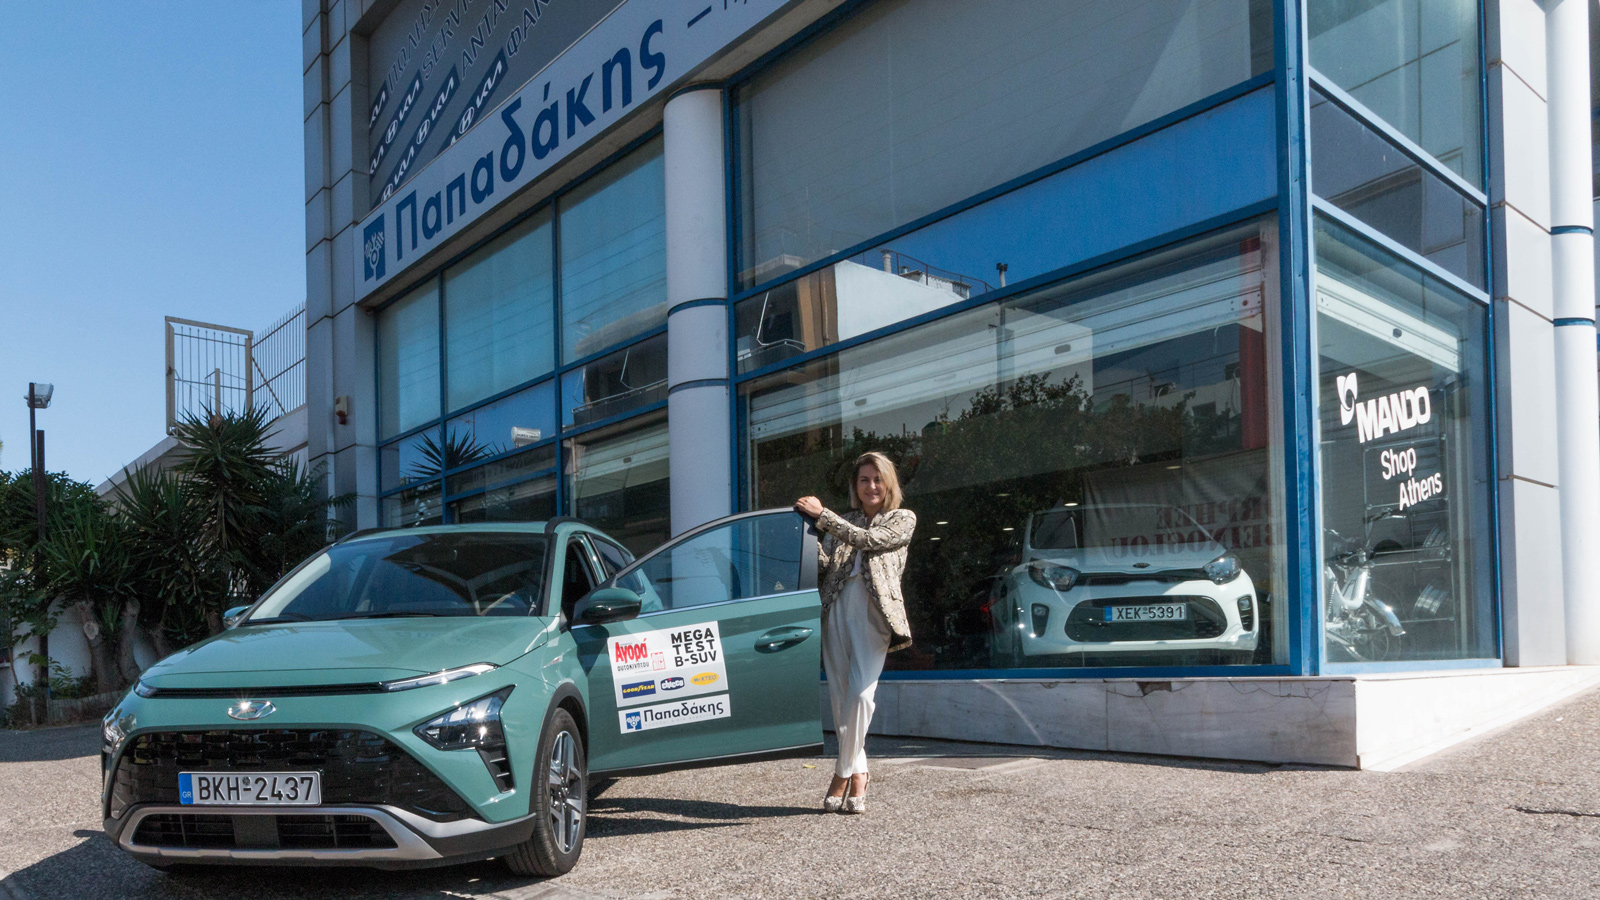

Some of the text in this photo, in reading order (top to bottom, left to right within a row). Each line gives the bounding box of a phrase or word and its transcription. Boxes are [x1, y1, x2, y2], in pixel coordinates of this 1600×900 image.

[395, 18, 667, 261] Παπαδάκης
[1355, 386, 1431, 443] MANDO
[1381, 447, 1417, 480] Shop
[1399, 472, 1443, 511] Athens
[670, 627, 715, 645] MEGA
[672, 639, 716, 656] TEST
[615, 637, 648, 664] Αγορά
[674, 650, 718, 668] B-SUV
[643, 701, 724, 722] Παπαδάκης
[182, 791, 192, 799] GR
